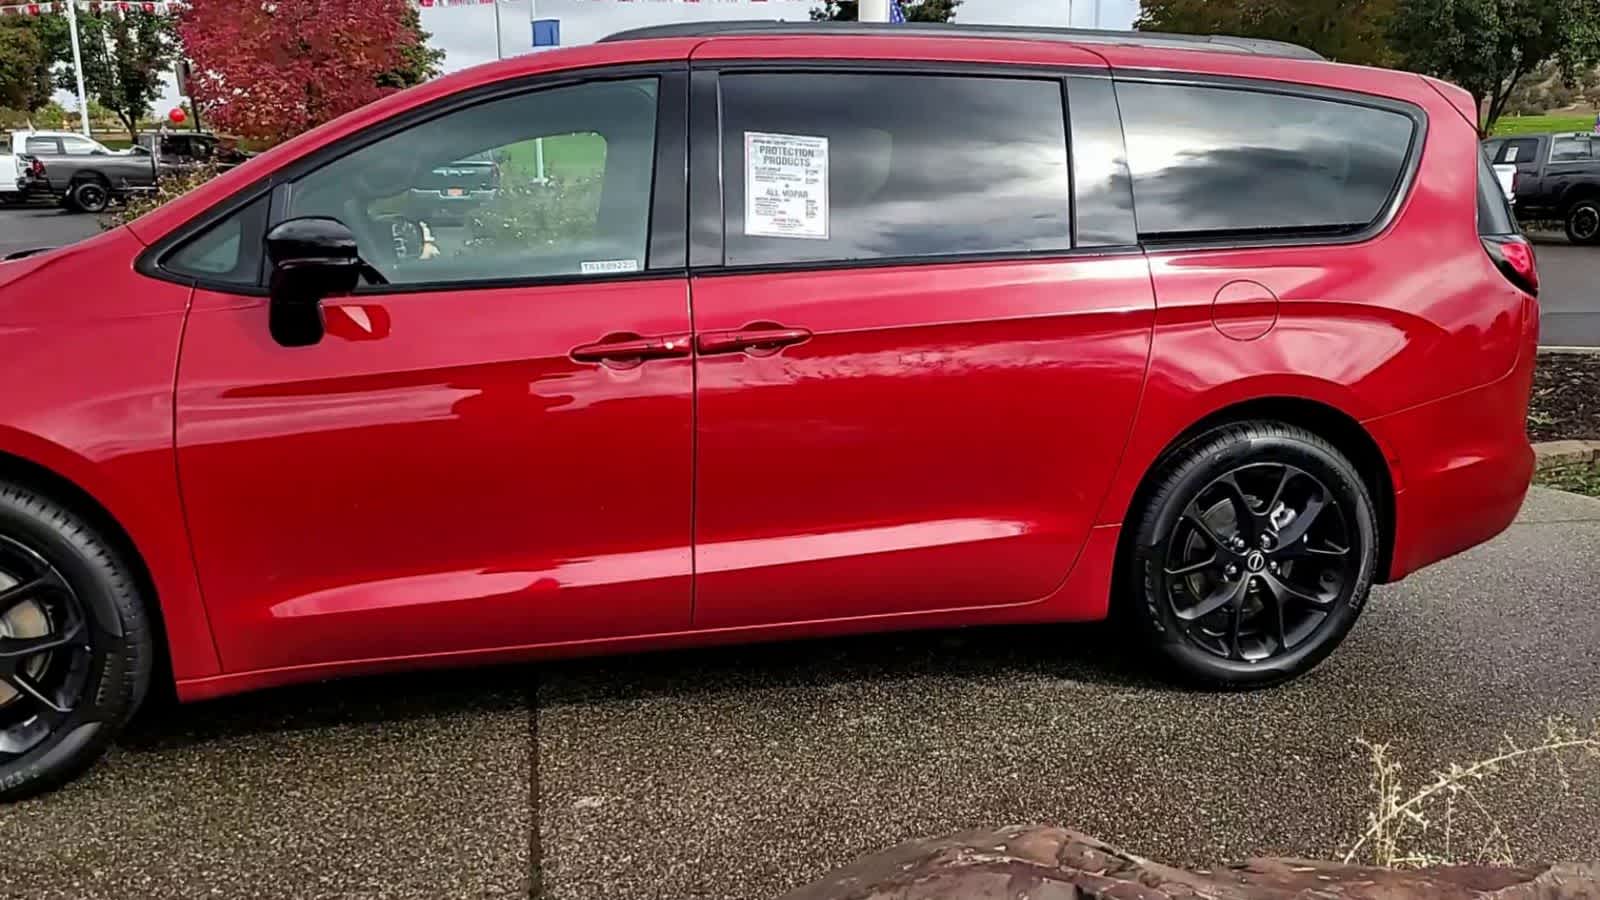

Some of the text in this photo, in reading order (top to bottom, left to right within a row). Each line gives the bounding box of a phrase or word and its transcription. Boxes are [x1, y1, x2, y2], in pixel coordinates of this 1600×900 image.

[759, 145, 815, 158] PROTECTION
[763, 156, 811, 167] PRODUCTS
[766, 187, 808, 199] ALL MOPAR
